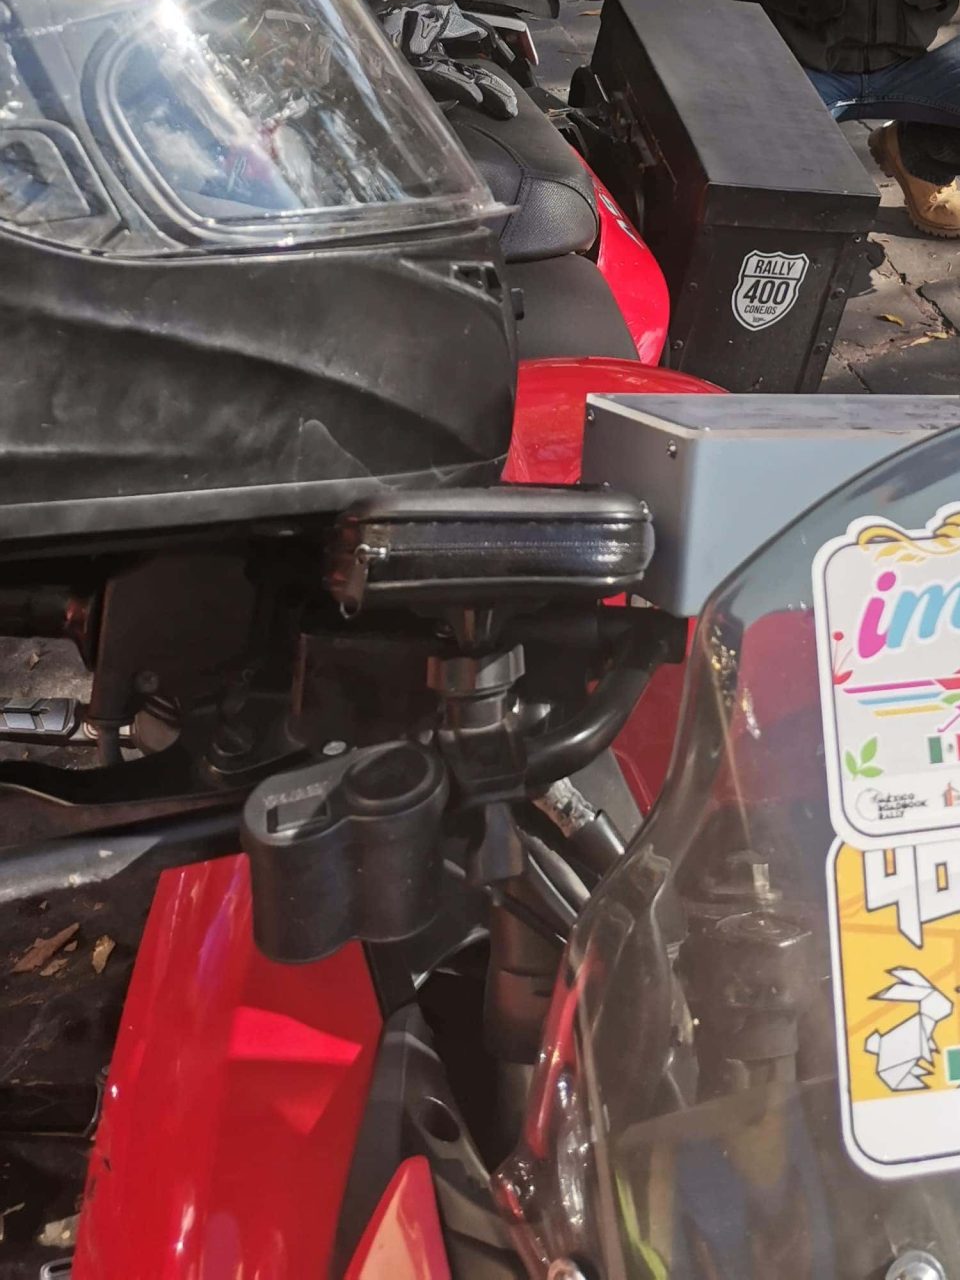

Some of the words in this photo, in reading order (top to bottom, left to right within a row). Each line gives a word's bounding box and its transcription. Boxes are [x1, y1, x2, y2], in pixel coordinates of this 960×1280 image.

[753, 259, 796, 276] RALLY
[743, 279, 790, 305] 400
[744, 304, 777, 315] CONEJOS
